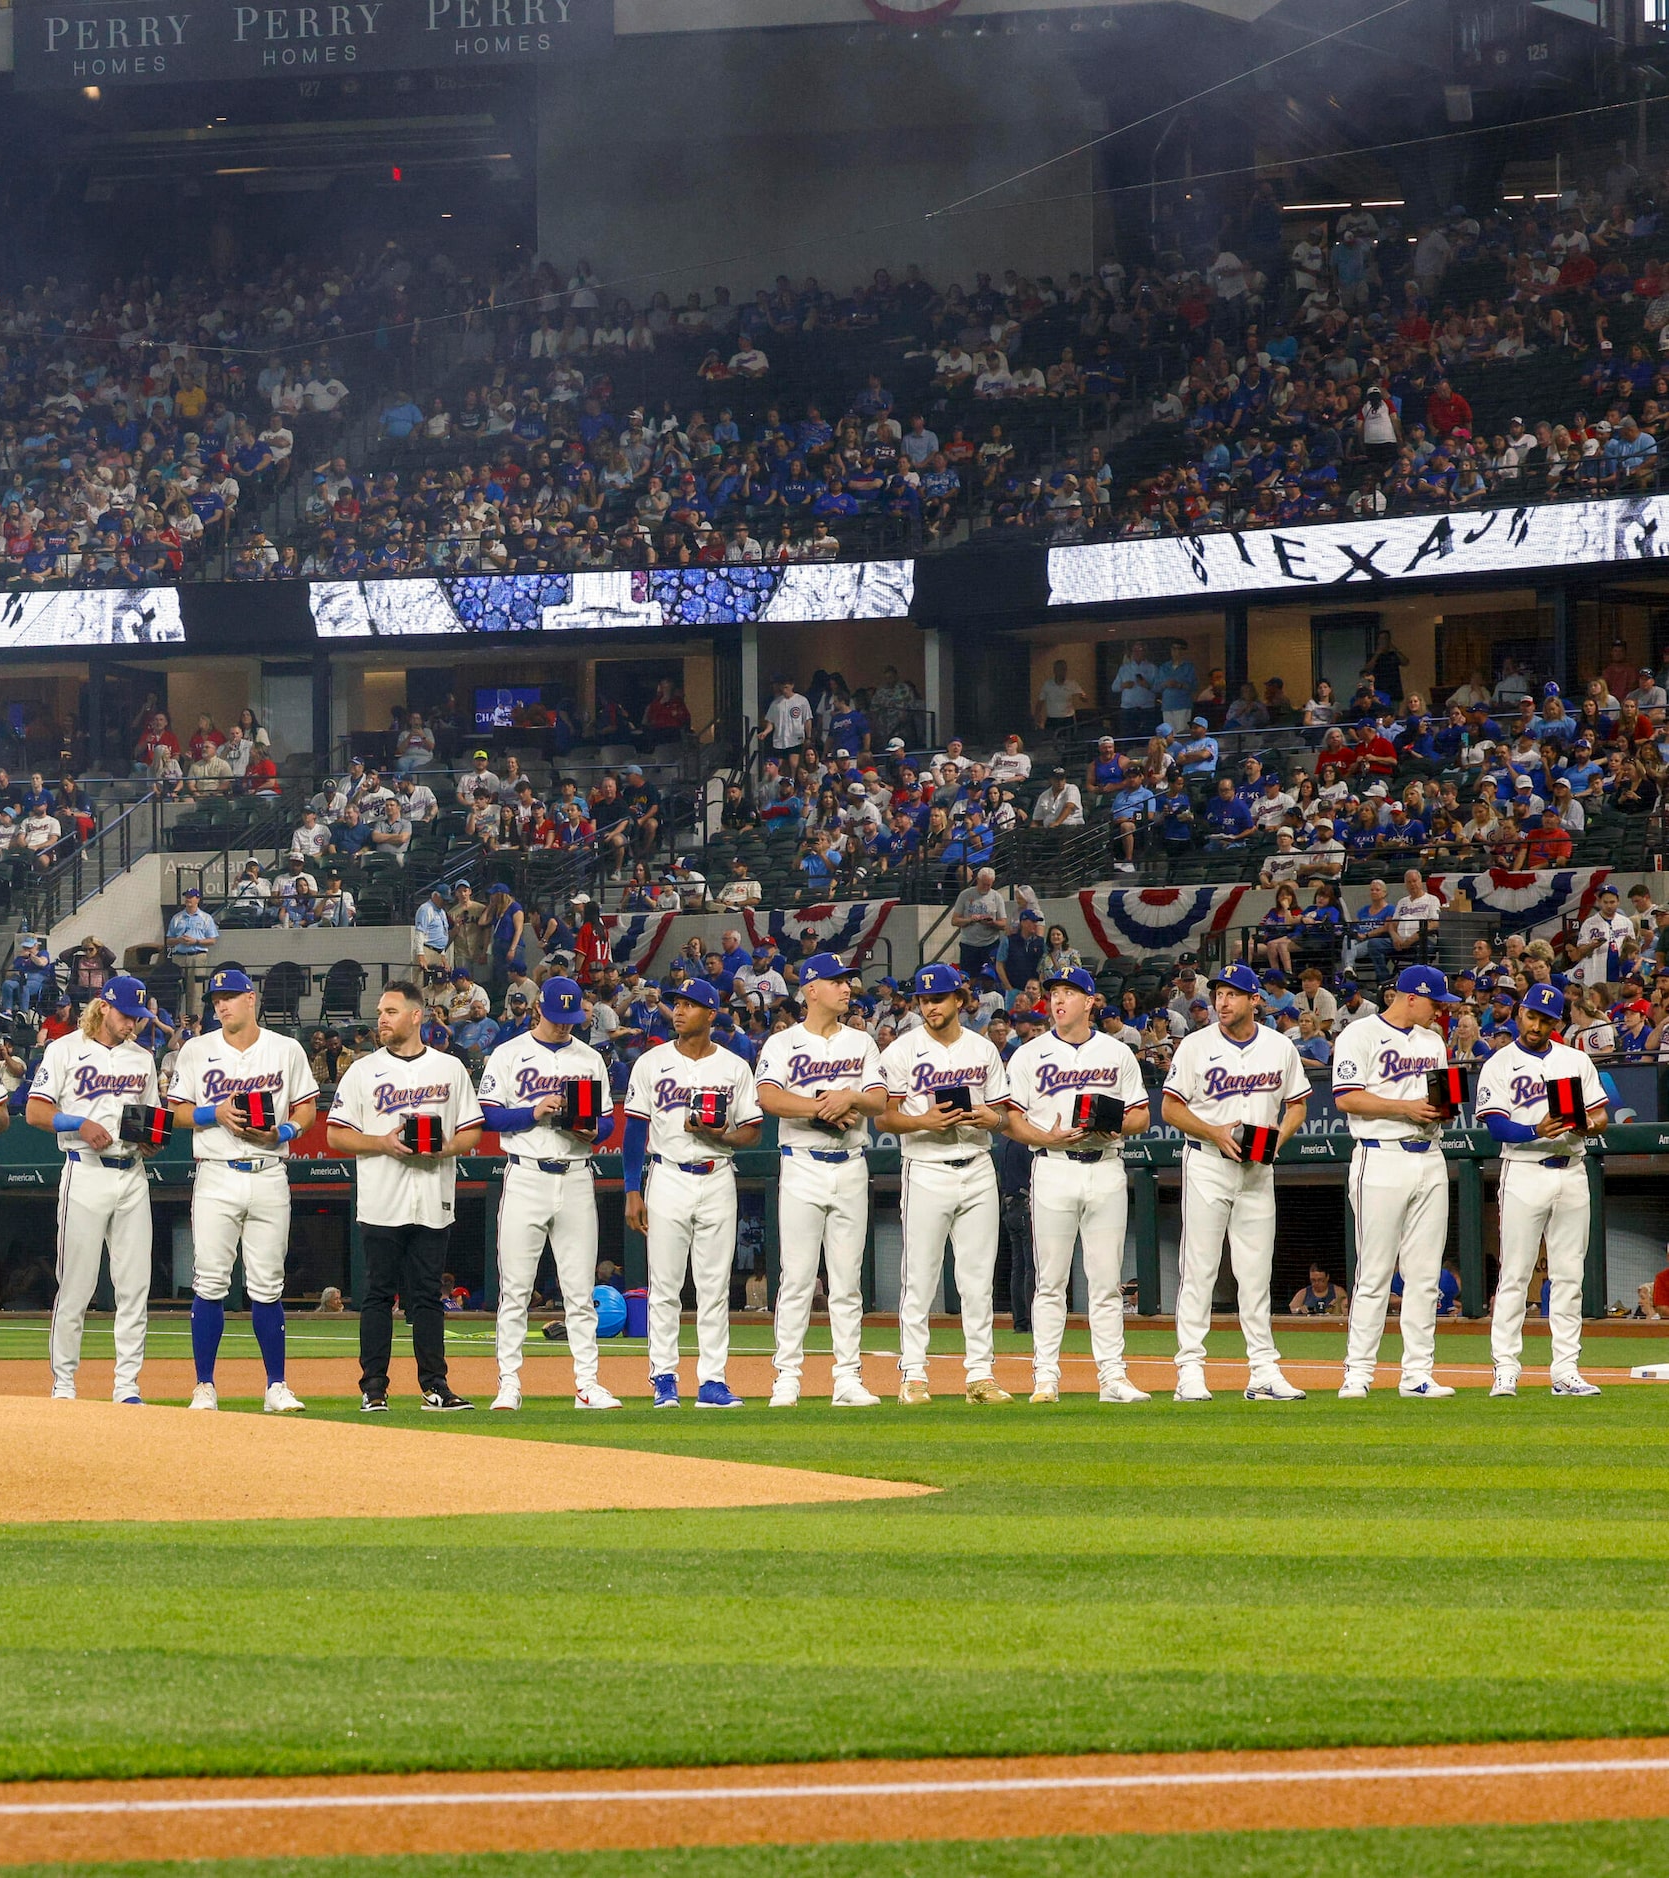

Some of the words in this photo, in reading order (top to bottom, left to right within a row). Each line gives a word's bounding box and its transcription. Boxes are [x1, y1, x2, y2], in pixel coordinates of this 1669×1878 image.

[233, 4, 380, 42] PERRY
[426, 0, 572, 31] PERRY
[44, 15, 192, 52] PERRY
[455, 34, 550, 55] HOMES
[1527, 43, 1548, 61] 125
[263, 45, 356, 66] HOMES
[73, 56, 166, 76] HOMES
[214, 972, 227, 987] T
[921, 973, 934, 989] T
[1060, 966, 1075, 980] T
[1224, 965, 1238, 979] T
[681, 979, 695, 992] T
[136, 989, 146, 1004] T
[560, 994, 573, 1009] T
[1540, 989, 1555, 1004] T
[73, 1065, 148, 1102] Rangers
[202, 1068, 284, 1103] Rangers
[911, 1062, 988, 1096] Rangers
[1035, 1063, 1119, 1099] Rangers
[1203, 1066, 1282, 1101] Rangers
[373, 1081, 451, 1117] Rangers
[1300, 1144, 1328, 1155] American
[309, 1167, 341, 1176] American
